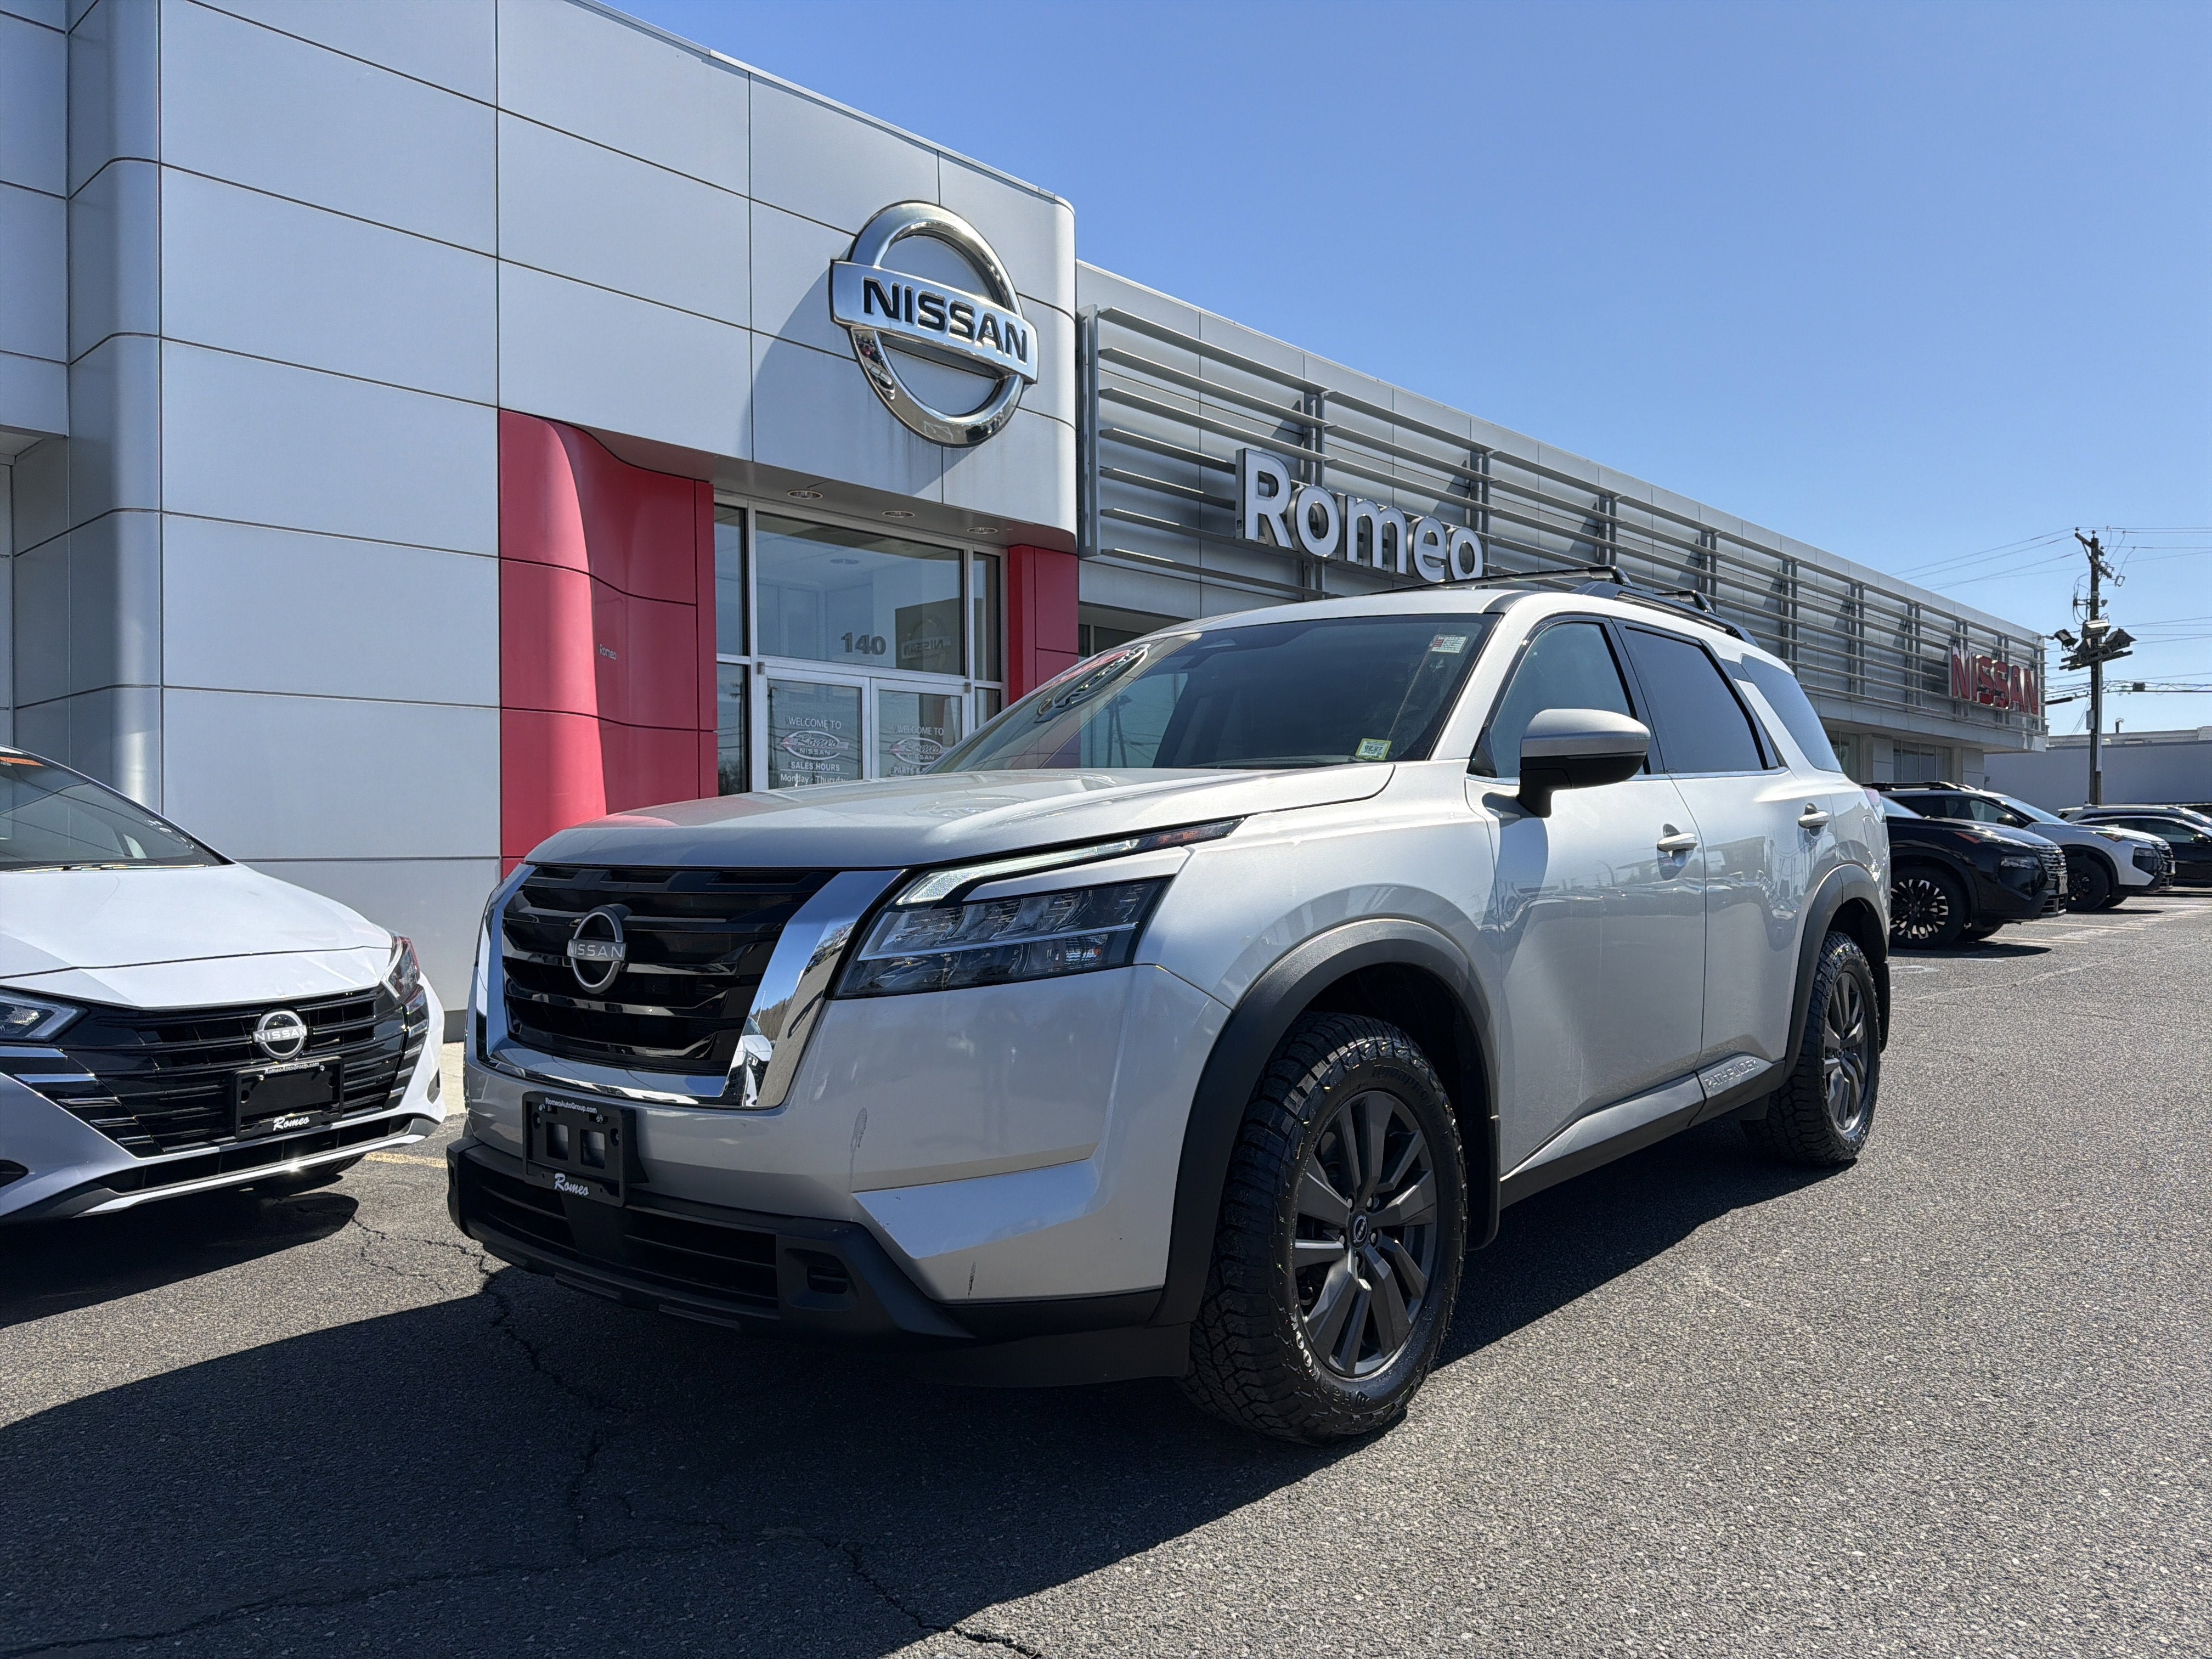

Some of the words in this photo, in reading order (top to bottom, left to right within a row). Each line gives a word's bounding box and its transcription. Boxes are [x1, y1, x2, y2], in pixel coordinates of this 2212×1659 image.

[863, 276, 1028, 365] NISSAN
[1237, 448, 1483, 583] Romeo
[841, 632, 886, 655] 140
[1949, 646, 2040, 715] NISSAN
[788, 716, 828, 729] WELCOME
[830, 720, 842, 730] TO
[897, 725, 932, 735] WELCOME
[933, 727, 944, 736] TO
[795, 732, 839, 747] Romeo
[791, 761, 814, 770] SALES
[815, 763, 840, 771] HOURS
[894, 766, 914, 775] PARTS
[780, 773, 810, 785] Monday
[567, 943, 623, 958] NISSAN
[255, 1027, 307, 1041] NISSAN
[264, 1062, 320, 1075] RomeoAutoGroup.com
[545, 1097, 597, 1114] RomeoAutoGroup.com
[273, 1116, 310, 1131] Romeo
[554, 1172, 589, 1197] Romeo
